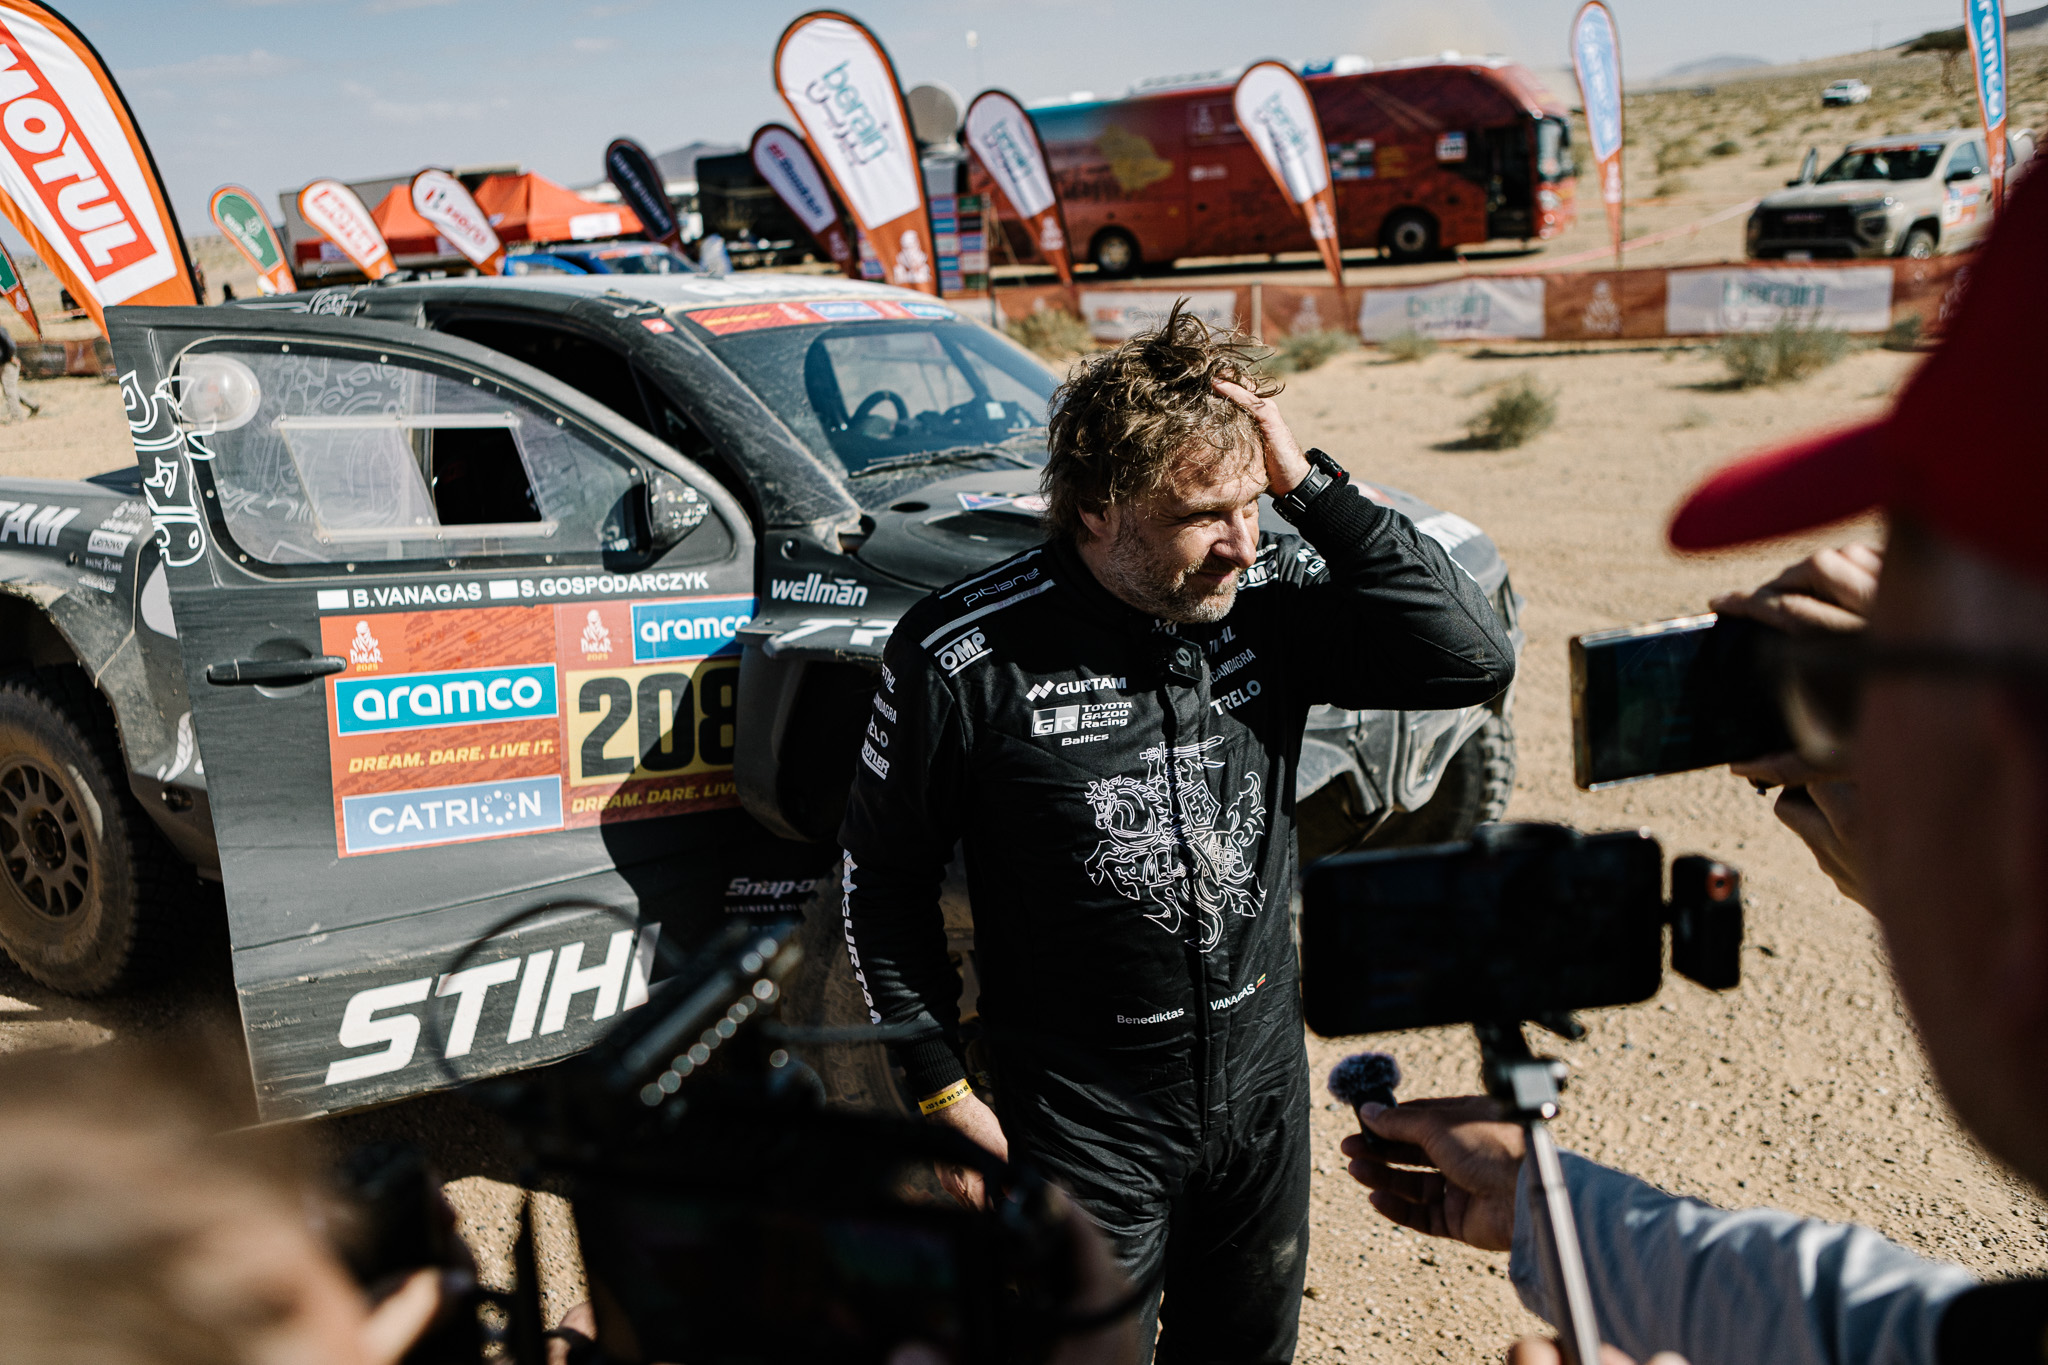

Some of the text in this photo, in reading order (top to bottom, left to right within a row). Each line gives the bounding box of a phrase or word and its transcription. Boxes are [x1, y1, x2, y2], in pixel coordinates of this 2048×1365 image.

[352, 582, 483, 609] B.VANAGAS
[520, 571, 710, 598] S.GOSPODARCZYK
[963, 567, 1040, 607] pitlane
[940, 631, 986, 670] OMP
[1209, 648, 1257, 686] CANDAGRA
[352, 676, 543, 721] aramco
[1056, 677, 1127, 695] GURTAM
[1081, 709, 1129, 721] GAZOO
[1082, 702, 1132, 713] TOYOTA
[578, 666, 740, 779] 208
[1033, 716, 1077, 735] GR
[1081, 717, 1128, 730] Racing
[1061, 733, 1110, 747] Baltics
[348, 739, 555, 774] DREAM. DARE. LIVE IT.
[571, 790, 643, 814] DREAM.
[646, 785, 700, 806] DARE.
[1210, 983, 1256, 1011] VANAGAS
[1116, 1007, 1185, 1025] Benediktas
